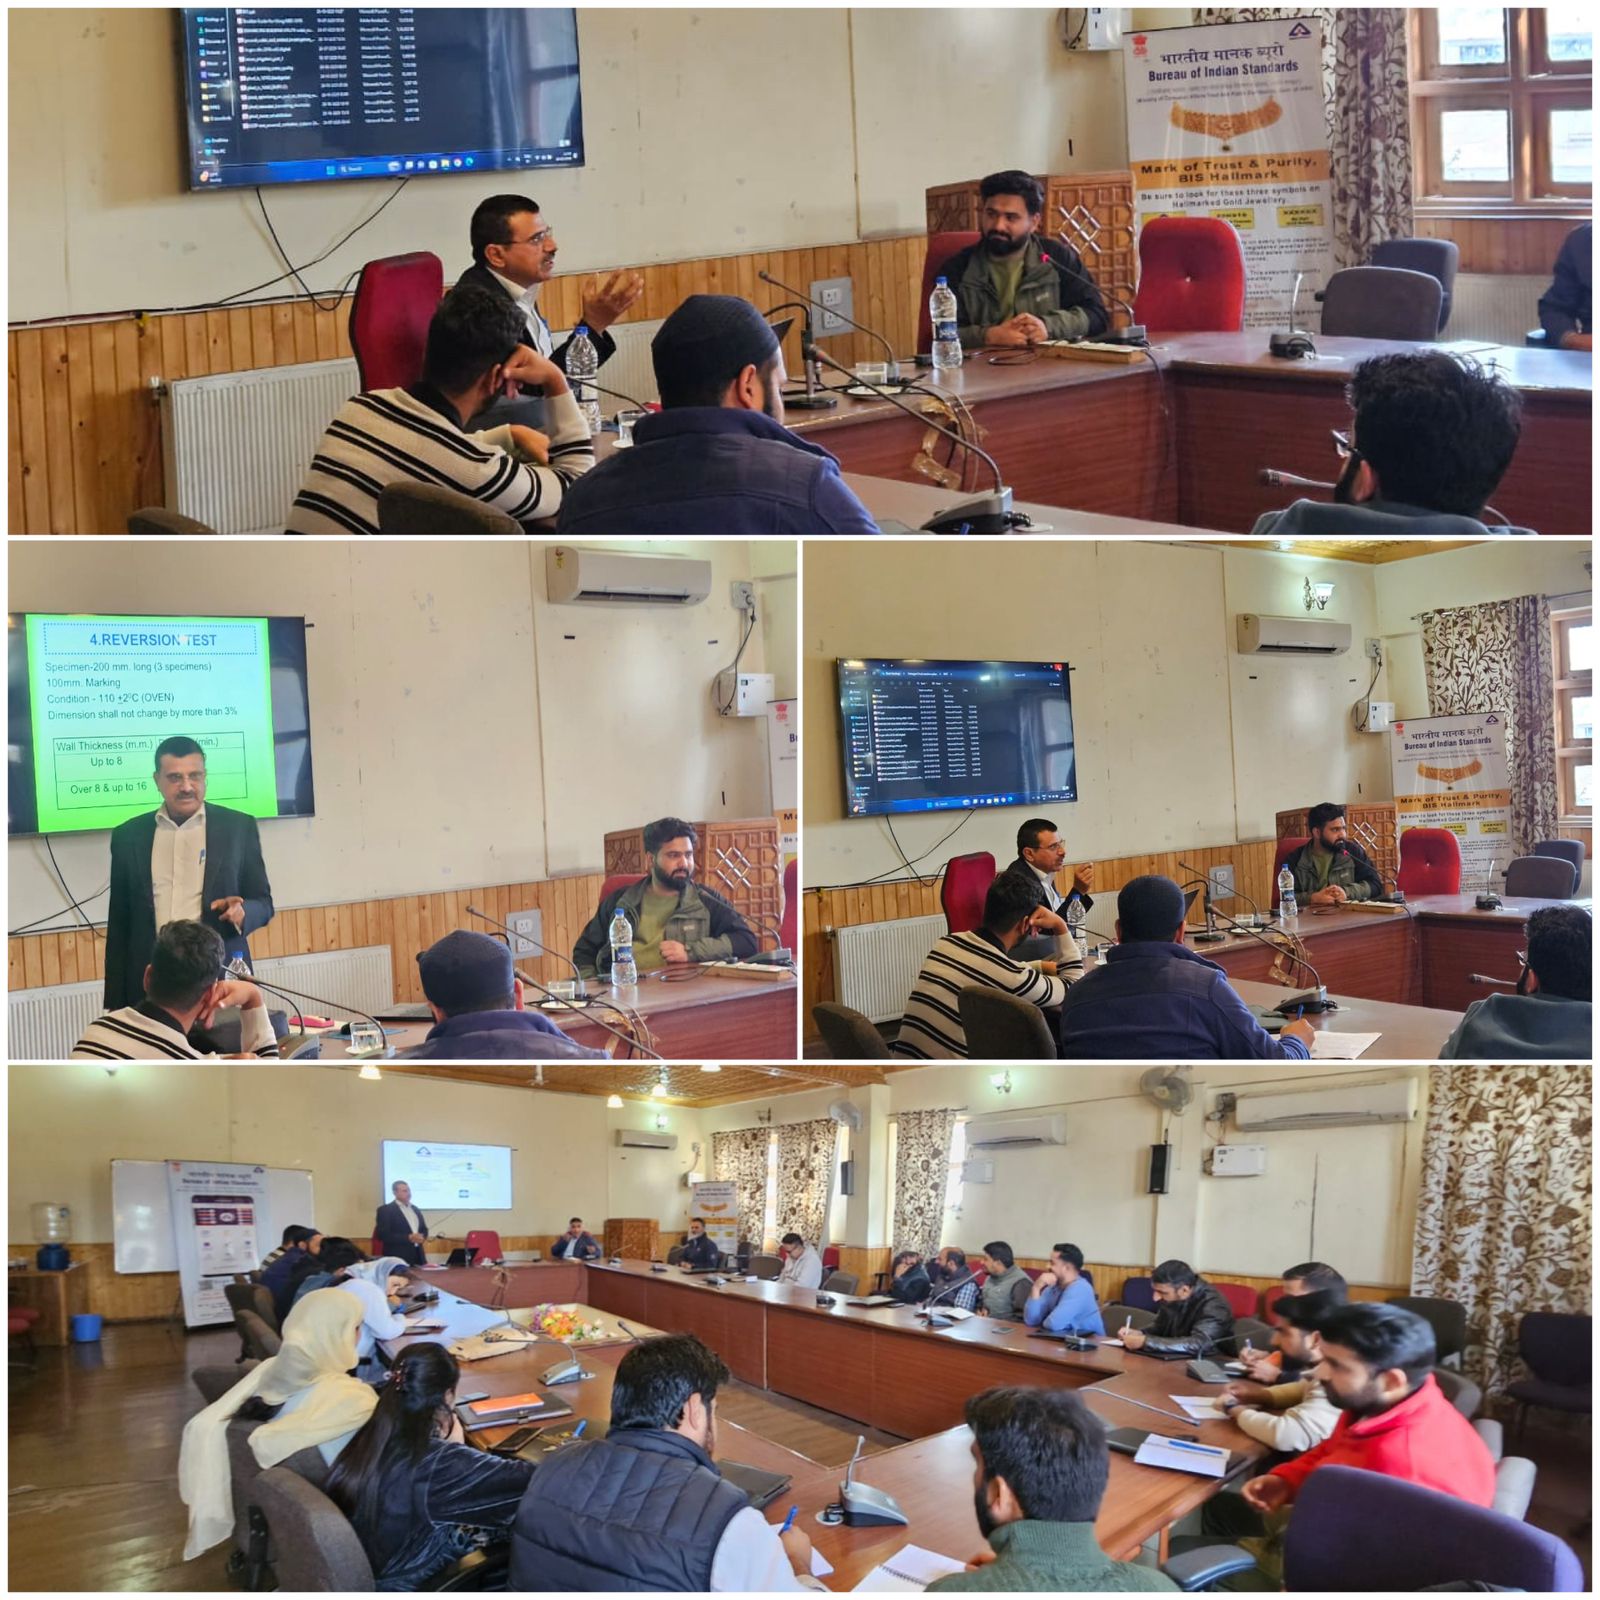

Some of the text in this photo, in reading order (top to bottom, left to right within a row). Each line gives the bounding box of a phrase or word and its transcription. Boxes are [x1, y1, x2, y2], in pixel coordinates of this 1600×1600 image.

[1160, 48, 1208, 65] भारतीय
[1214, 47, 1252, 61] मानक
[1148, 60, 1299, 82] Bureau of Indian Standards
[1141, 163, 1177, 174] Mark
[1184, 161, 1198, 172] of
[1203, 159, 1243, 170] Trust
[1249, 159, 1260, 169] &
[1178, 169, 1279, 183] BIS Hallmark
[1141, 193, 1152, 201] Be
[1154, 192, 1172, 200] sure
[1175, 191, 1184, 199] to
[1186, 190, 1204, 199] look
[1206, 189, 1218, 198] for
[1220, 188, 1243, 197] these
[1246, 187, 1268, 196] three
[1271, 185, 1306, 196] symbols
[1172, 199, 1221, 208] Hallmarked
[1223, 198, 1242, 206] Gold
[90, 633, 217, 647] 4.REVERSION TEST
[45, 662, 212, 673] Specimen-200 mm. long (3 specimens)
[47, 678, 121, 689] 100mm. Marking
[47, 694, 90, 704] Condition
[99, 694, 115, 703] 110
[141, 693, 175, 704] (OVEN)
[48, 706, 237, 720] Dimension shall not change by more than 3%
[56, 742, 76, 751] Wall
[79, 740, 123, 751] Thickness
[125, 739, 153, 750] (m.m.)
[1404, 742, 1427, 750] Bureau
[1436, 739, 1458, 747] Indian
[1459, 736, 1492, 746] Standards
[91, 756, 123, 767] Up to 8
[70, 781, 147, 794] Over 8 & up to 16
